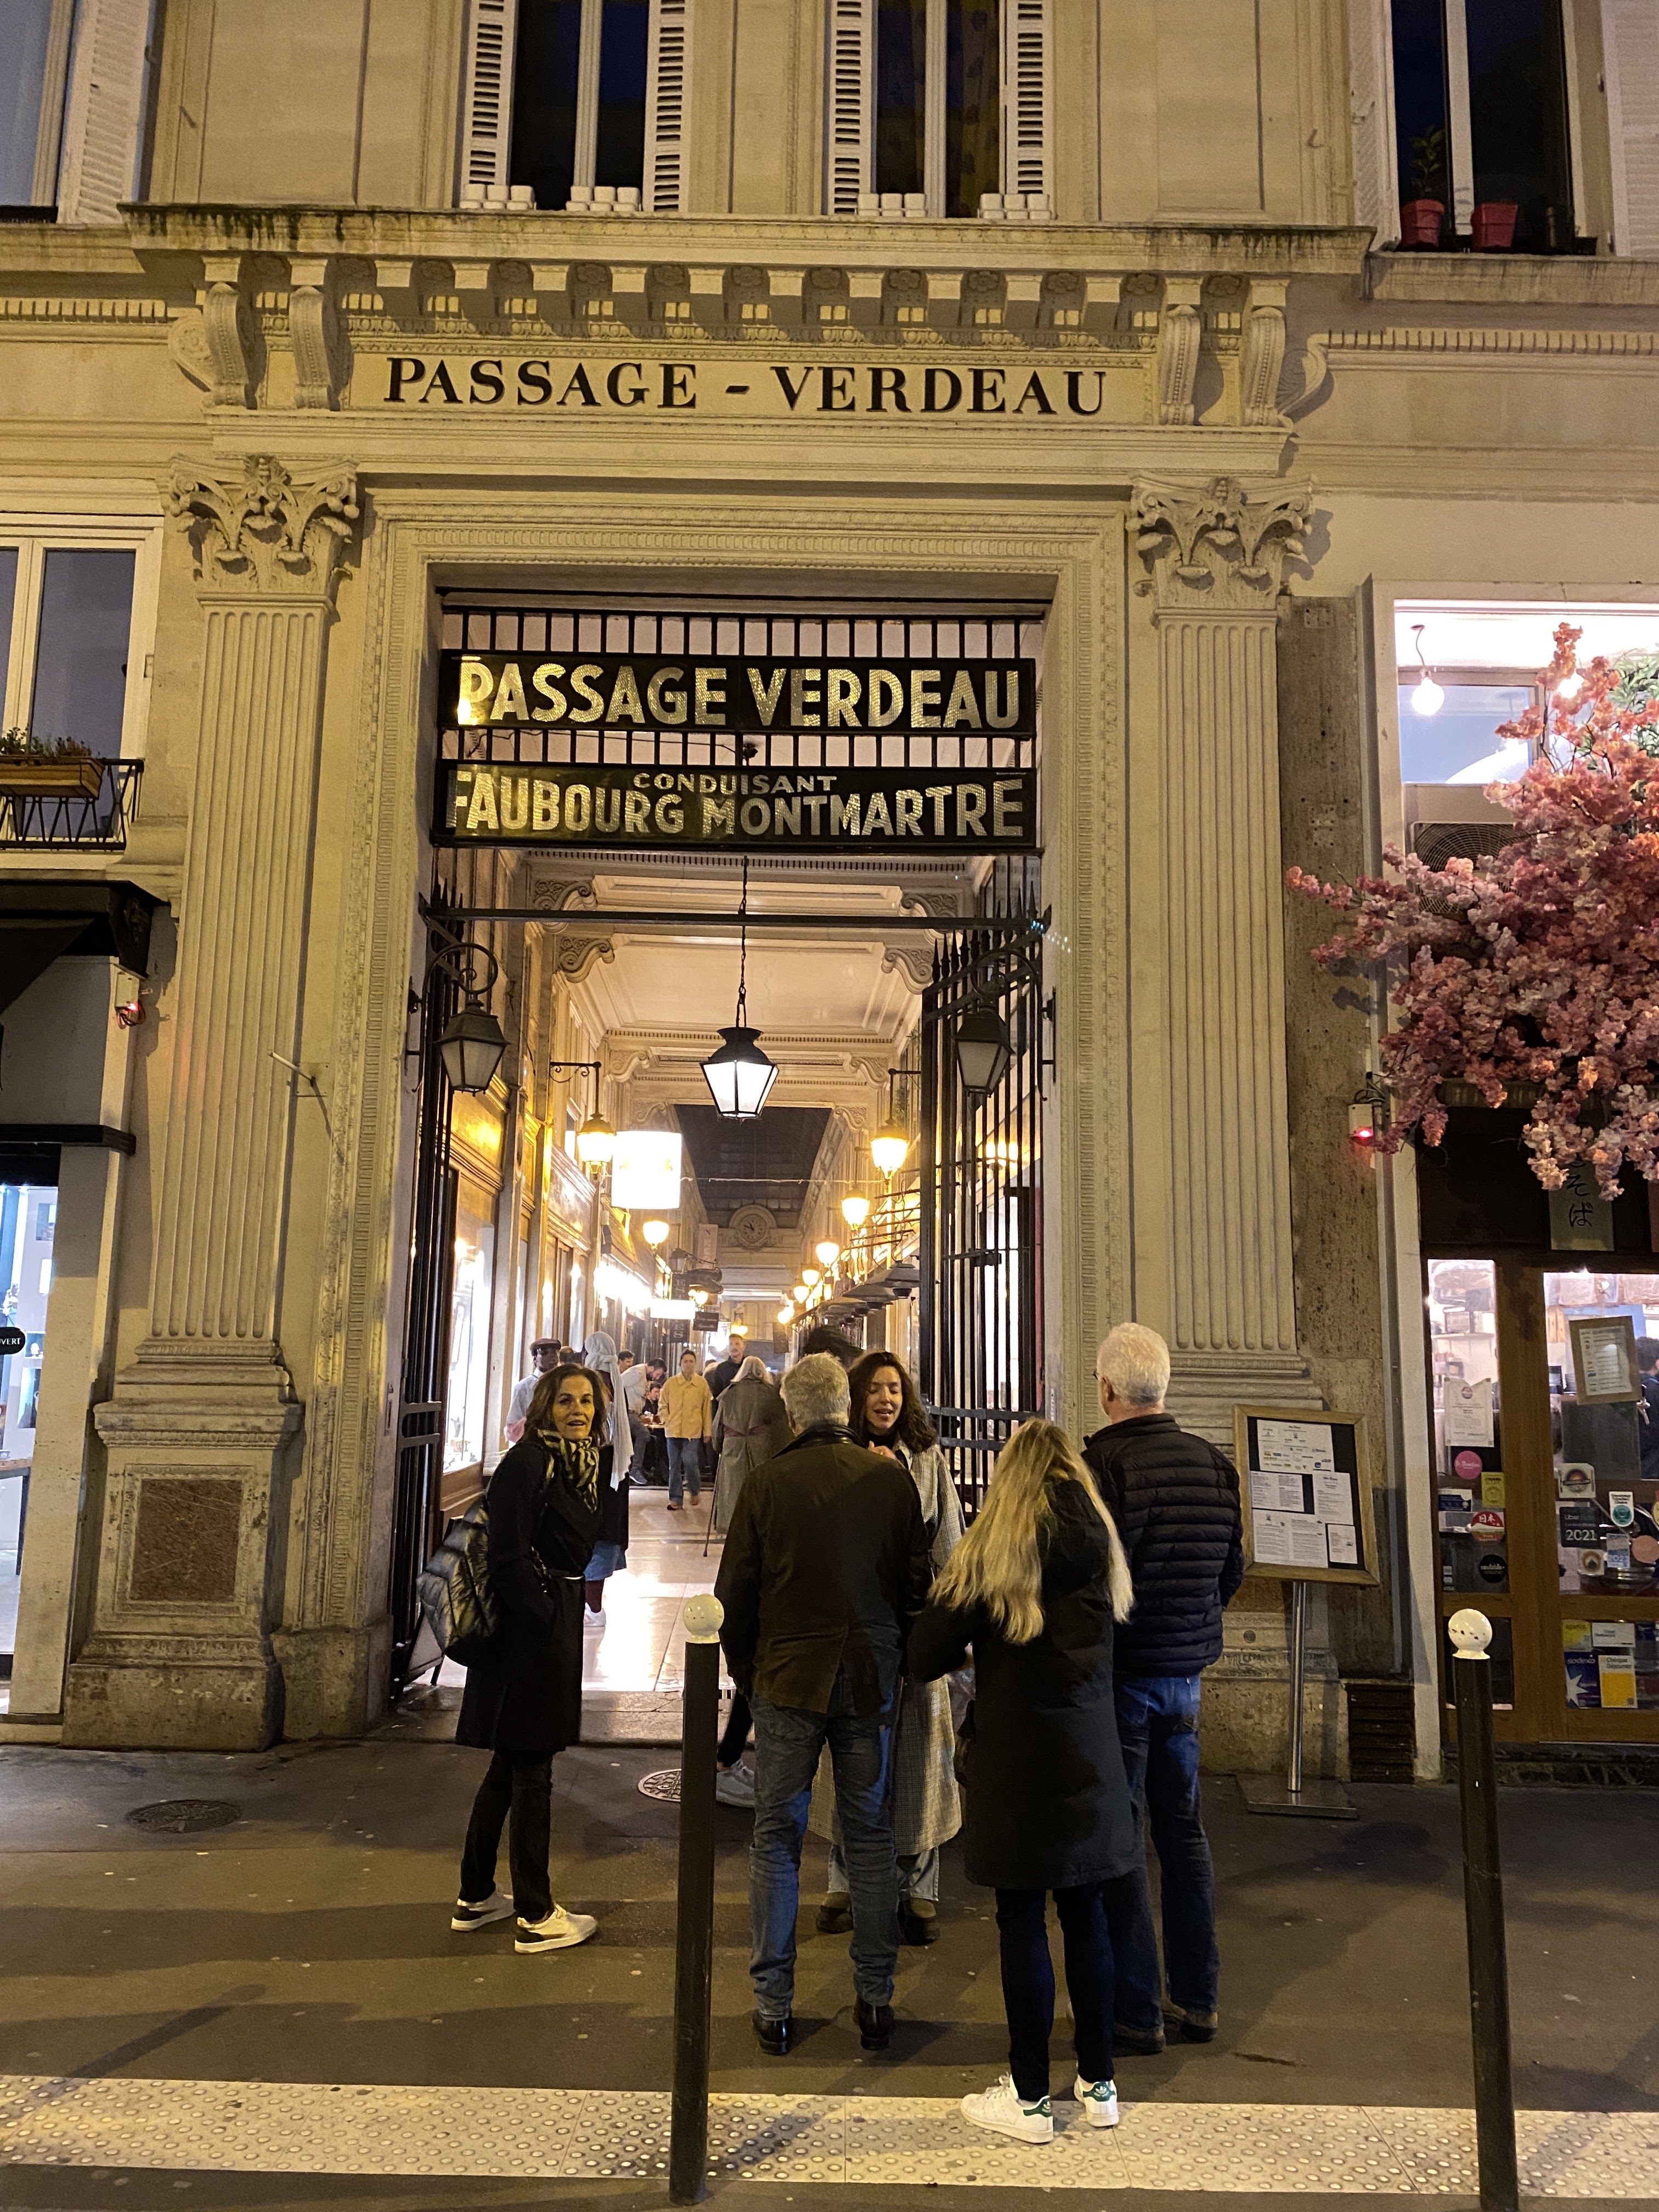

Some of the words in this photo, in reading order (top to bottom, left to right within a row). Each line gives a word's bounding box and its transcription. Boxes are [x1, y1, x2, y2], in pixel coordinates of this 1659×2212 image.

[383, 357, 697, 409] PASSAGE
[770, 365, 1107, 416] VERDEAU
[458, 659, 727, 726] PASSAGE
[747, 667, 1019, 729] VERDEAU
[445, 769, 685, 834] FAUBOURG
[701, 778, 1024, 838] MONTMARTRE
[633, 771, 838, 795] CONDUISANT
[0, 1337, 21, 1345] VERT
[1565, 1529, 1598, 1541] 2021
